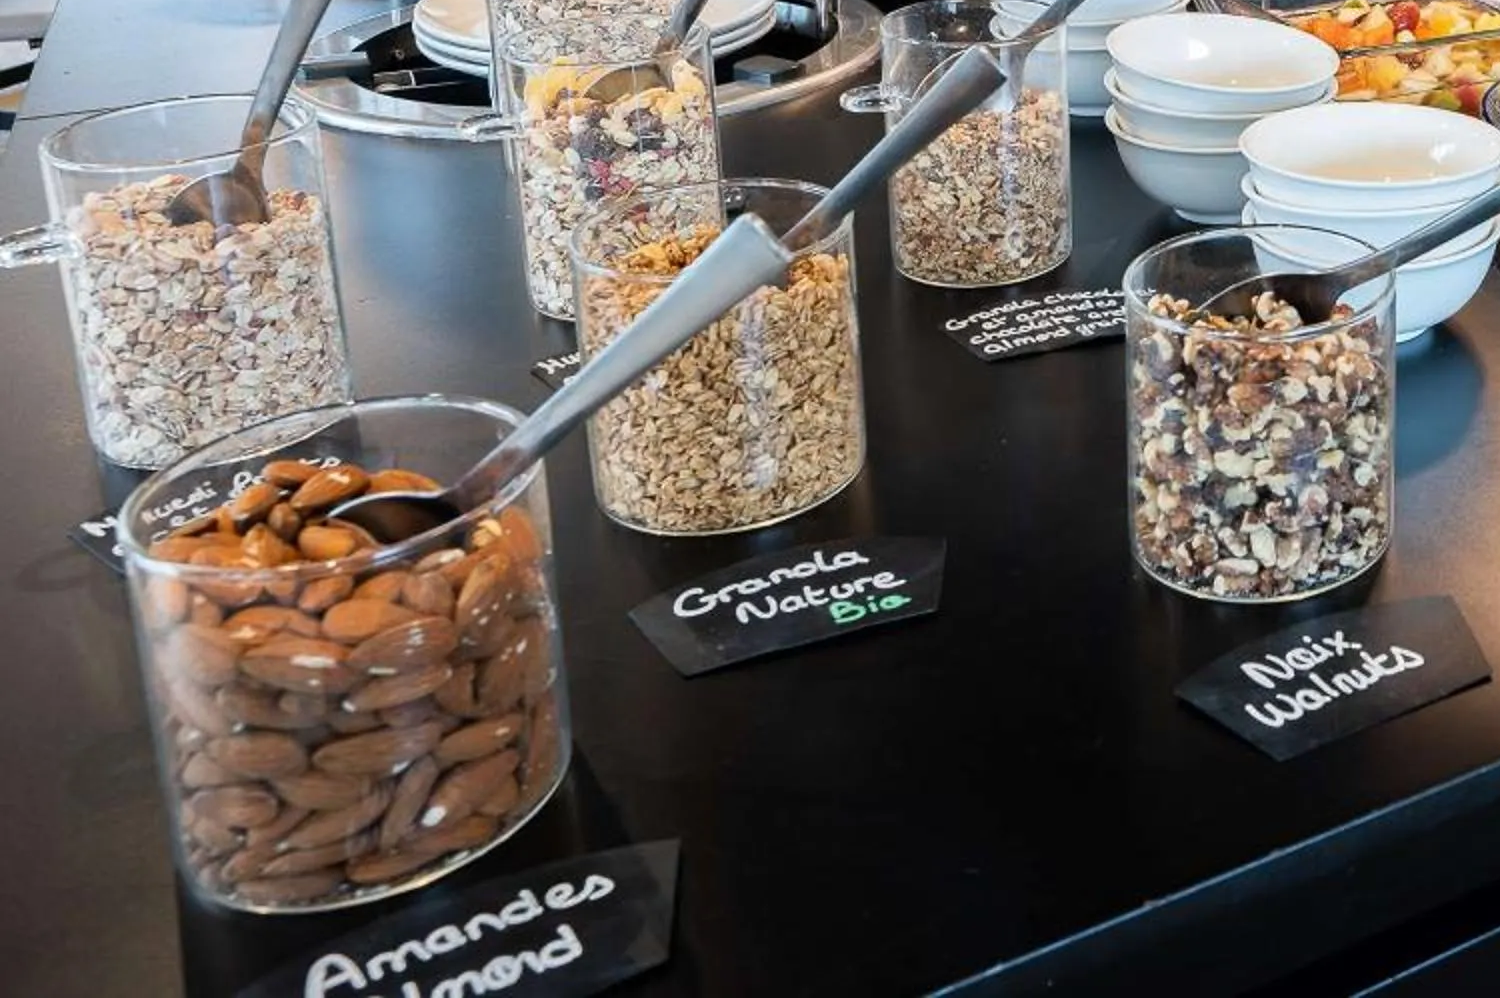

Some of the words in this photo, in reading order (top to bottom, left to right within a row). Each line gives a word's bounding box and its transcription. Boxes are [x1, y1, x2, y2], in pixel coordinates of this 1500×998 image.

[673, 551, 870, 618] Granola
[735, 570, 907, 624] Nature
[828, 594, 912, 625] Bio
[1240, 629, 1363, 690] Noix
[304, 874, 615, 998] Amandes
